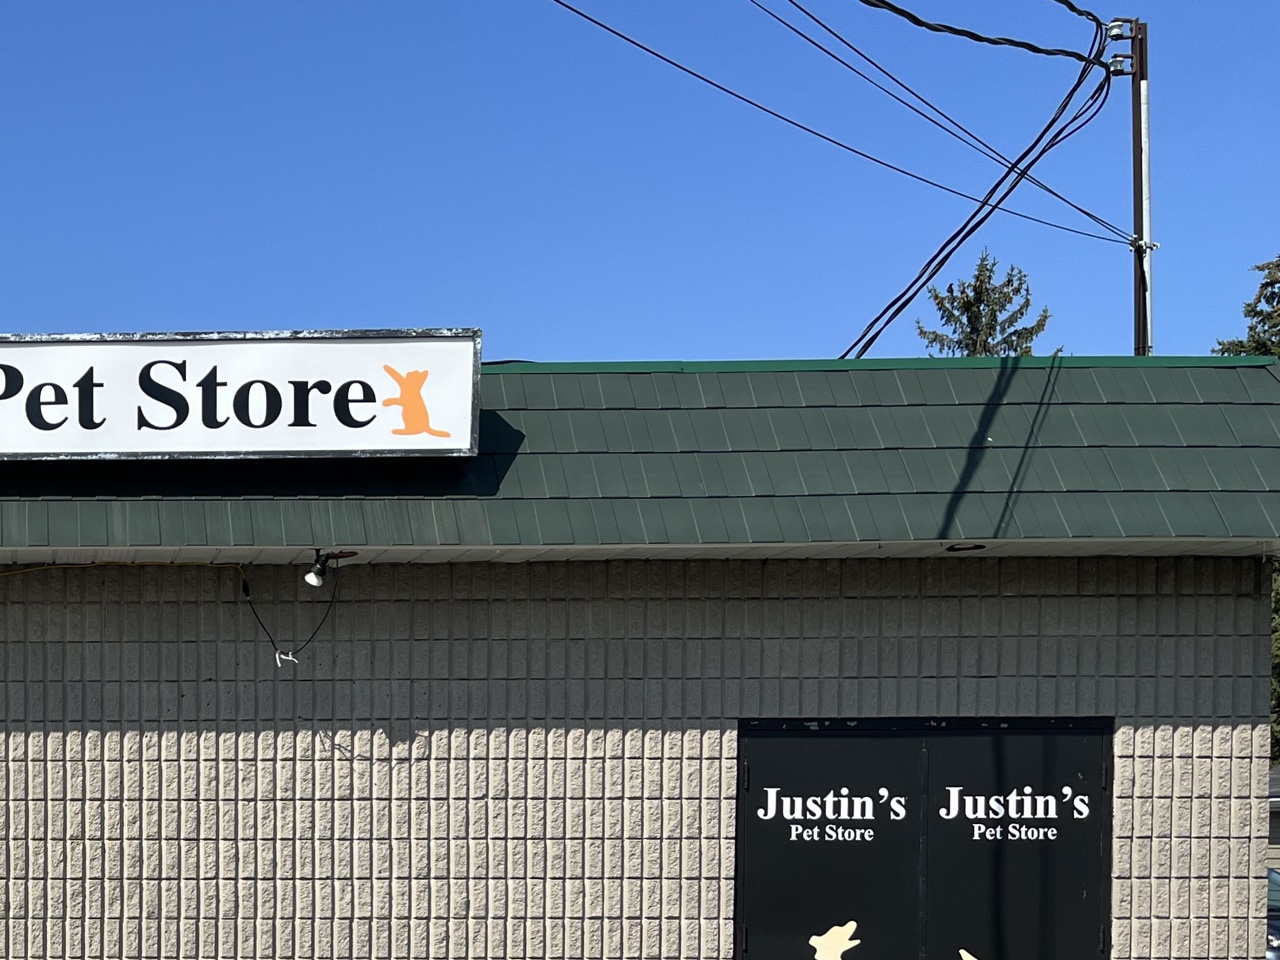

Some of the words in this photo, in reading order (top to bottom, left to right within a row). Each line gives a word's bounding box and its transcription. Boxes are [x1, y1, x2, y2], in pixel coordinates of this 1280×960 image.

[137, 360, 377, 431] Store
[757, 788, 907, 820] Justin's
[939, 786, 1090, 819] Justin's
[790, 825, 821, 841] Pet
[825, 825, 874, 841] Store
[973, 824, 1003, 840] Pet
[1008, 824, 1058, 840] Store
